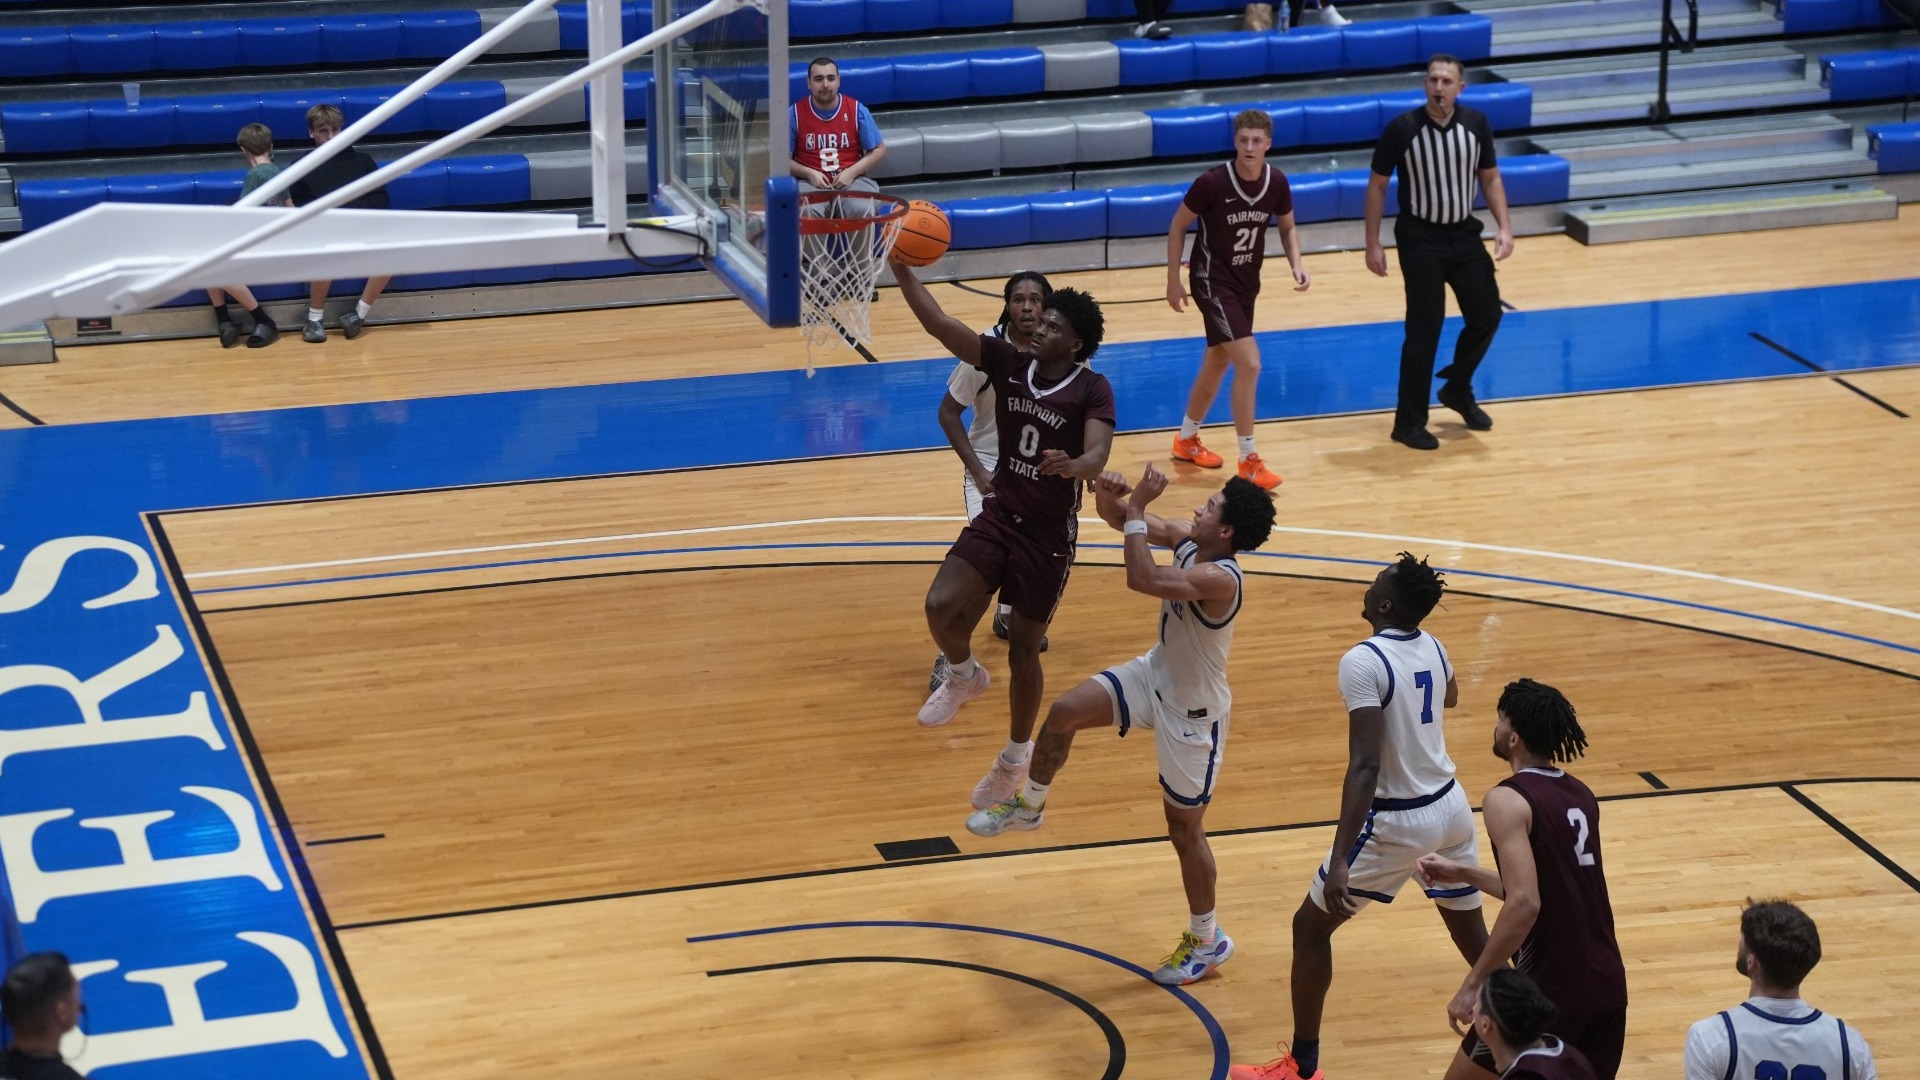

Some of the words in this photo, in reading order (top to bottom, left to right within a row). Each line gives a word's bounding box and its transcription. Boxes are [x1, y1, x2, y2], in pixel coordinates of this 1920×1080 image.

[817, 132, 849, 149] NBA
[819, 147, 840, 172] 8
[1226, 211, 1269, 225] FAIRMONT
[1233, 227, 1259, 252] 21
[1231, 253, 1254, 266] STATE
[1008, 397, 1067, 430] FAIRMONT
[1018, 423, 1040, 458] 0
[1009, 457, 1040, 480] STATE
[1414, 670, 1433, 725] 7
[1566, 807, 1596, 867] 2
